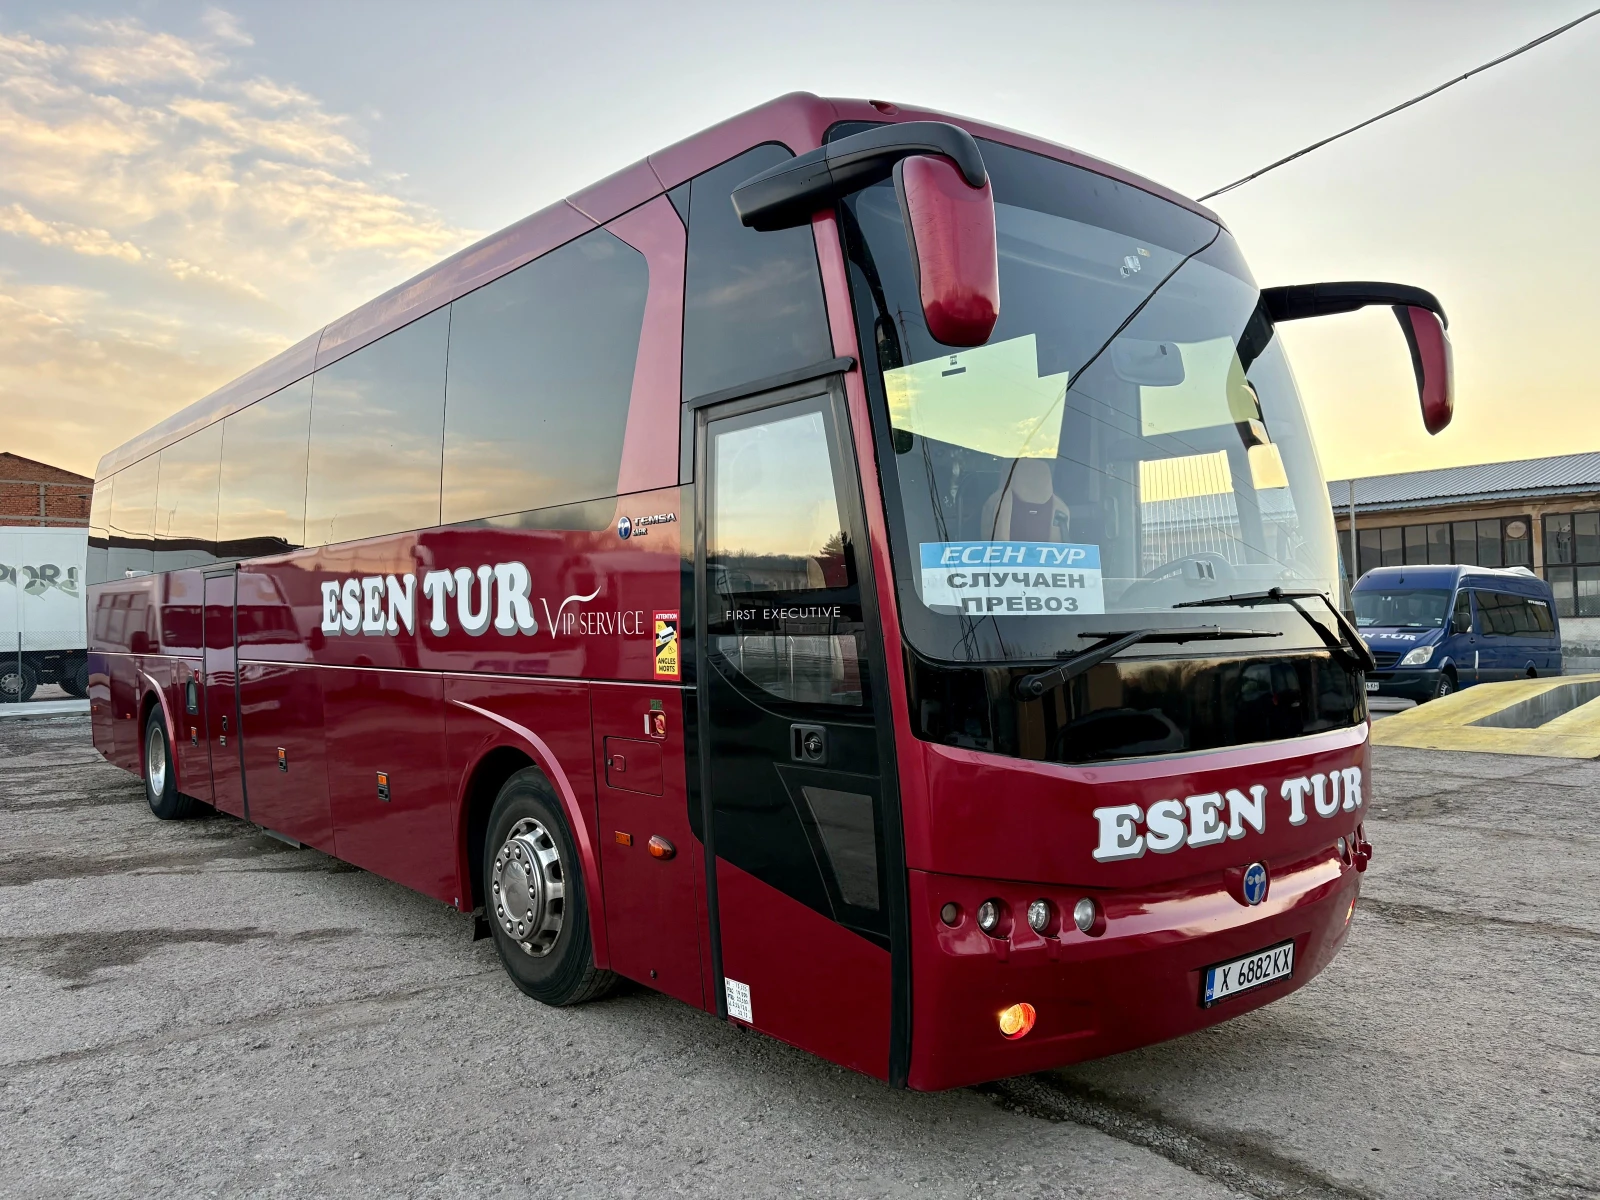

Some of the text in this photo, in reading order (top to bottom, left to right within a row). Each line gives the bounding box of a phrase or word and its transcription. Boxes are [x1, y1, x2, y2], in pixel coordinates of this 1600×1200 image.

[633, 513, 677, 526] TEMSA
[940, 546, 1086, 565] ЕСЕН ТУР
[946, 572, 1085, 589] СЛУЧАЕН
[320, 561, 538, 637] ESEN TUR
[961, 597, 1079, 612] ПРЕВОЗ
[726, 606, 841, 620] FIRST EXECUTIVE
[579, 610, 645, 635] SERVICE
[1379, 633, 1416, 641] TUR
[658, 657, 676, 665] ANGLES
[1092, 766, 1363, 863] ESEN TUR
